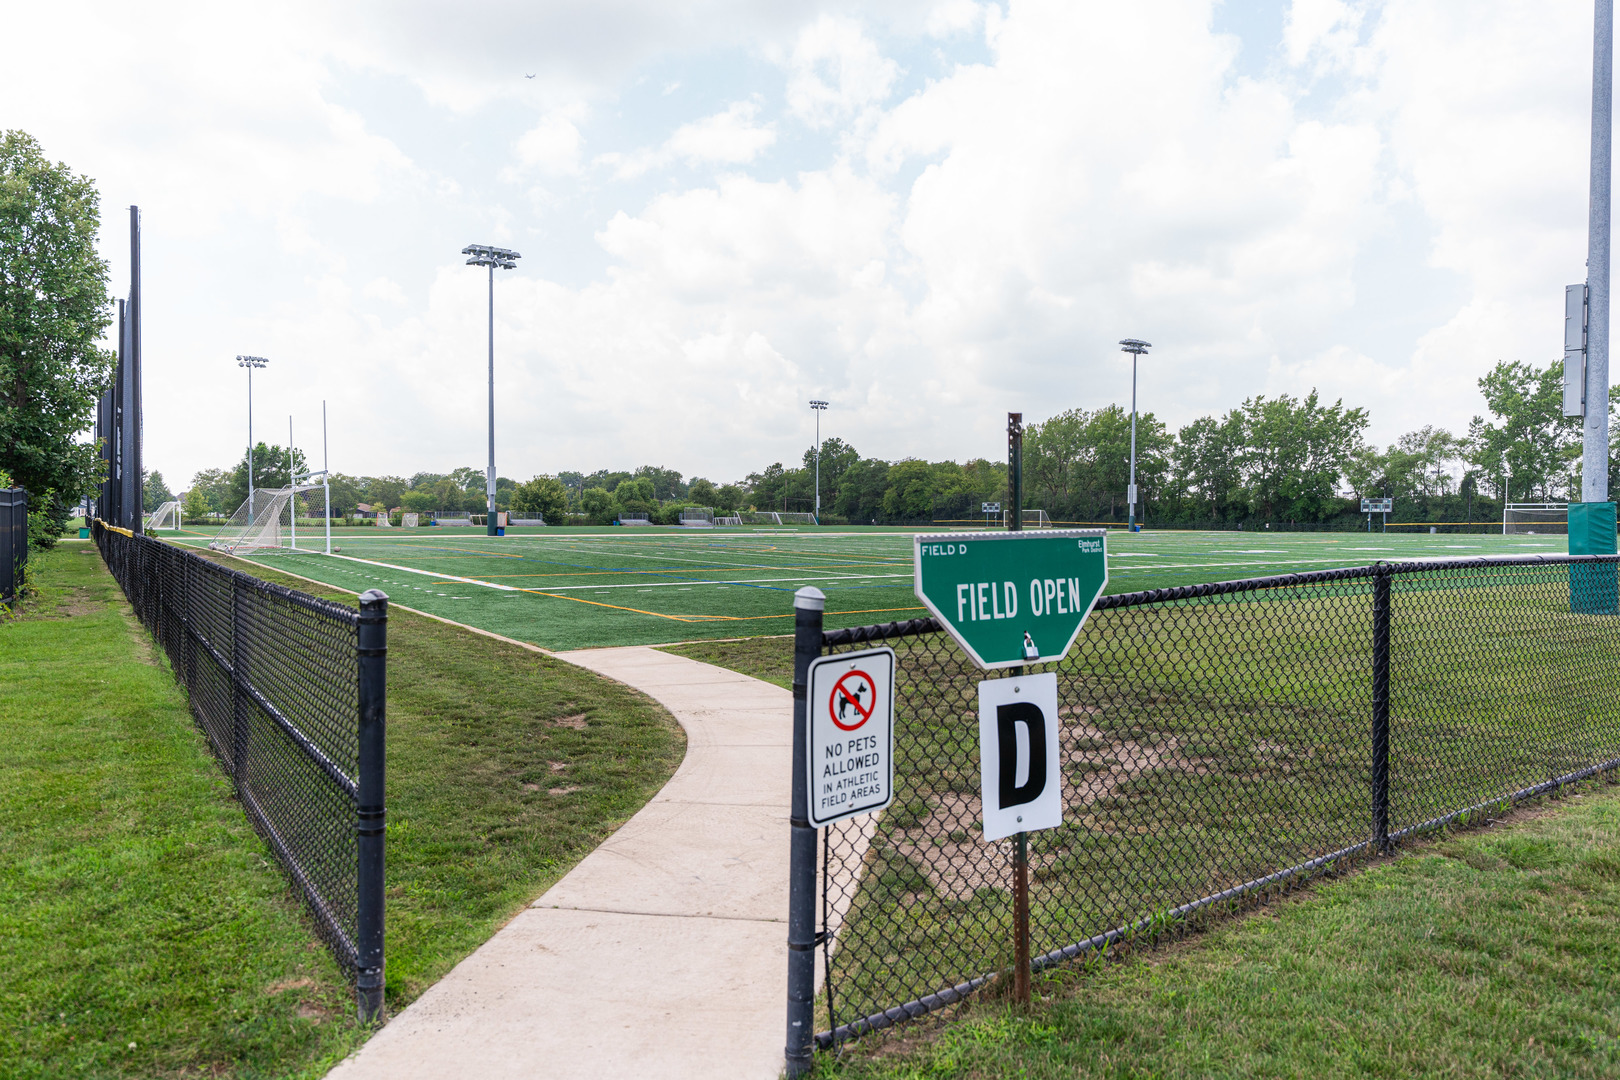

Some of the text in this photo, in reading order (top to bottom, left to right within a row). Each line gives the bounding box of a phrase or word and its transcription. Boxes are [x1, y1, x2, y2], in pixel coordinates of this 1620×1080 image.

[921, 544, 967, 556] FIELD D
[1078, 539, 1100, 548] Elmhurst
[957, 577, 1081, 622] FIELD OPEN
[825, 735, 877, 759] NO PETS
[996, 702, 1047, 810] D
[823, 752, 880, 778] ALLOWED
[823, 771, 879, 794] IN ATHLETIC
[821, 784, 881, 809] FIELD AREAS
